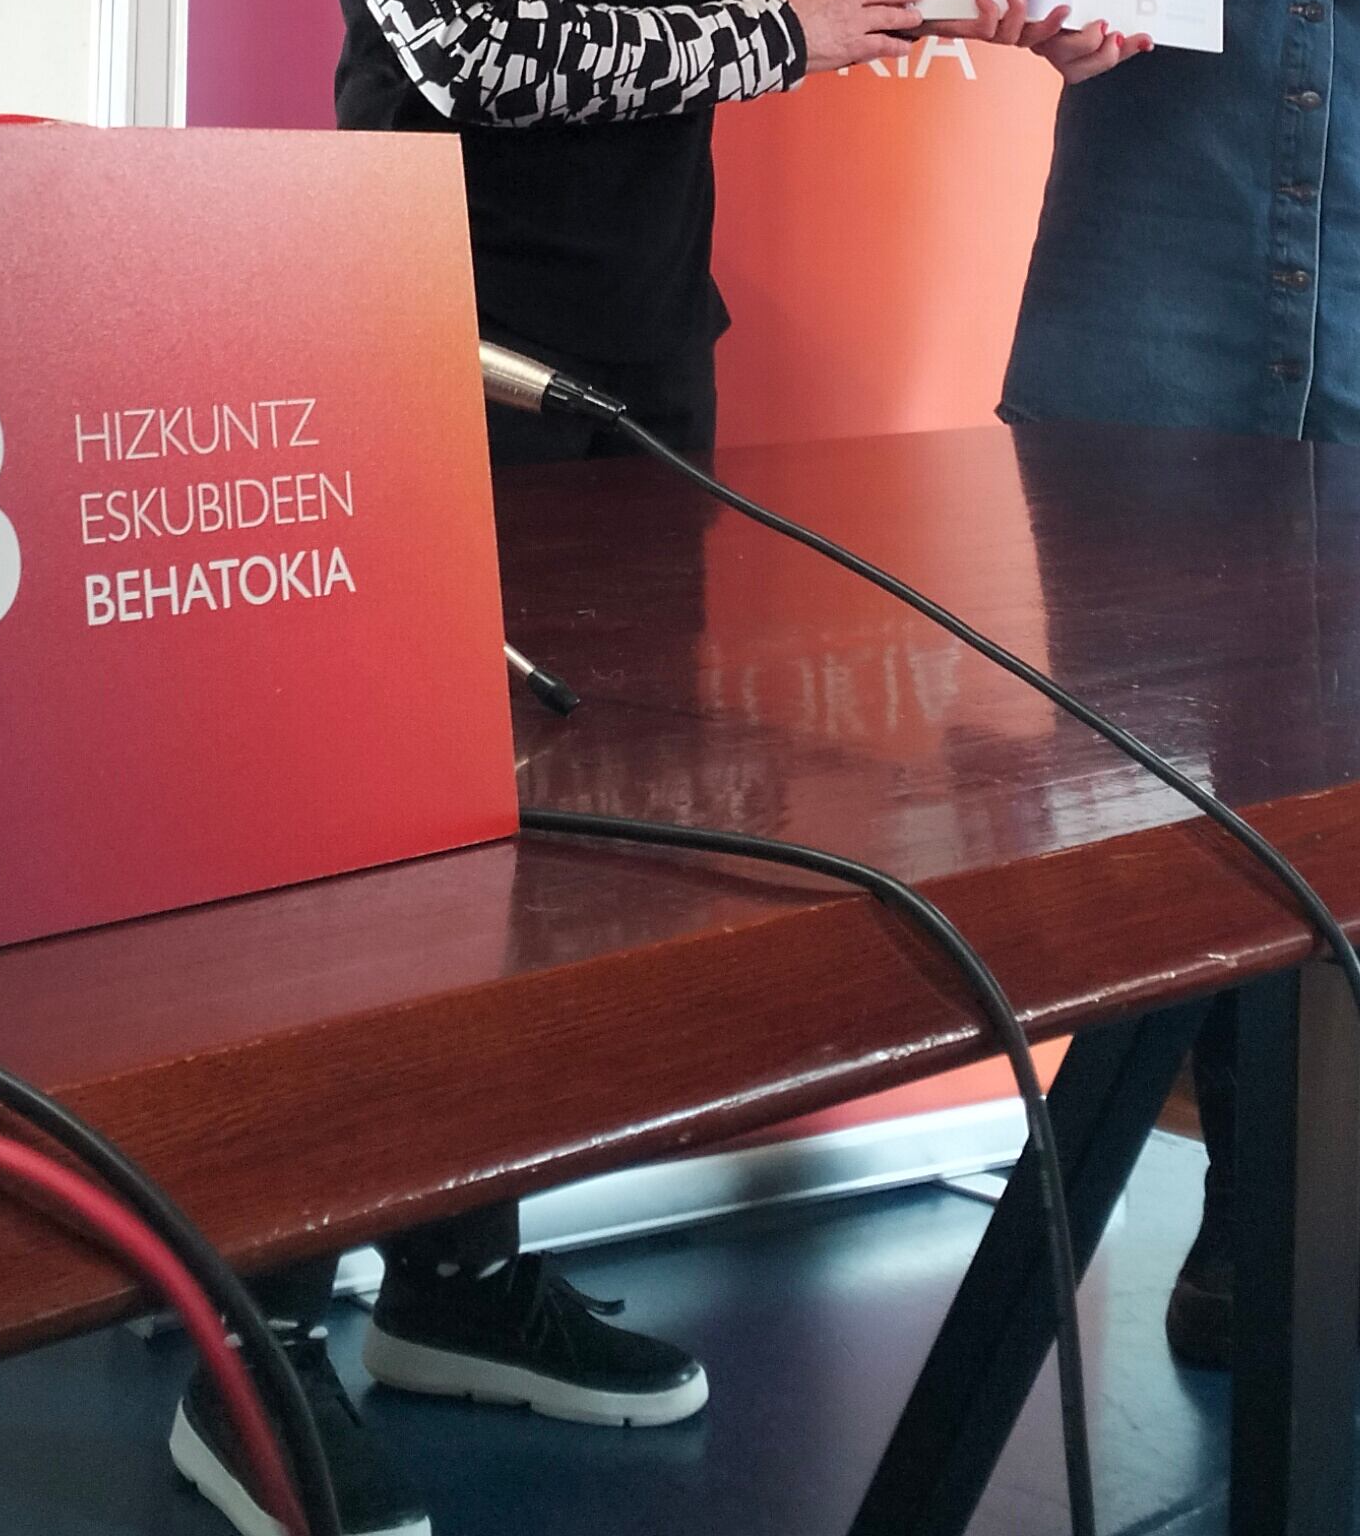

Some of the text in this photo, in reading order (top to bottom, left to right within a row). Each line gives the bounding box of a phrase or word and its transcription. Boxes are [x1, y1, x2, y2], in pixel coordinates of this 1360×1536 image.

[75, 398, 320, 463] HIZKUNTZ
[80, 470, 354, 544] ESKUBIDEEN
[85, 546, 357, 626] BEHATOKIA
